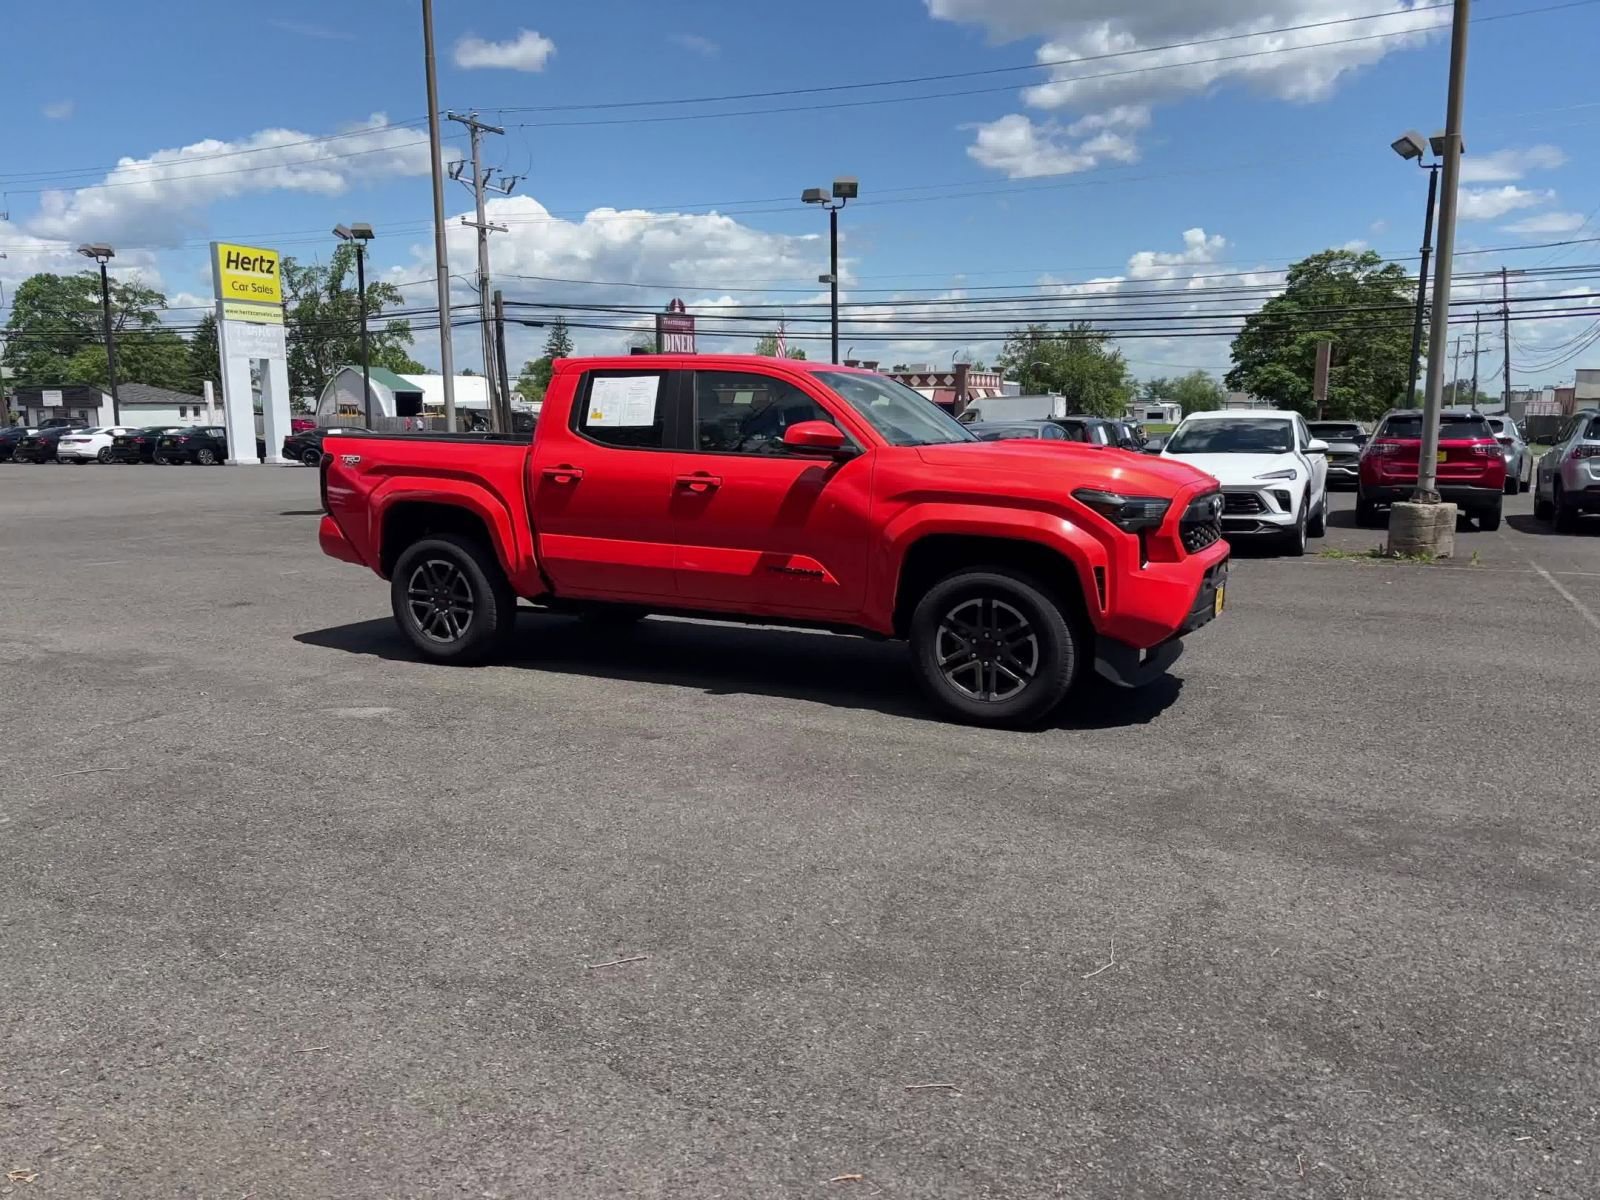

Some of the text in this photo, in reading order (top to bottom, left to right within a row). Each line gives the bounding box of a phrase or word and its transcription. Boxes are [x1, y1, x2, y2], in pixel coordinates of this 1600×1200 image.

[226, 251, 275, 274] Hertz
[231, 281, 274, 294] Car Sales
[663, 334, 693, 352] DINER
[340, 455, 360, 463] TRD
